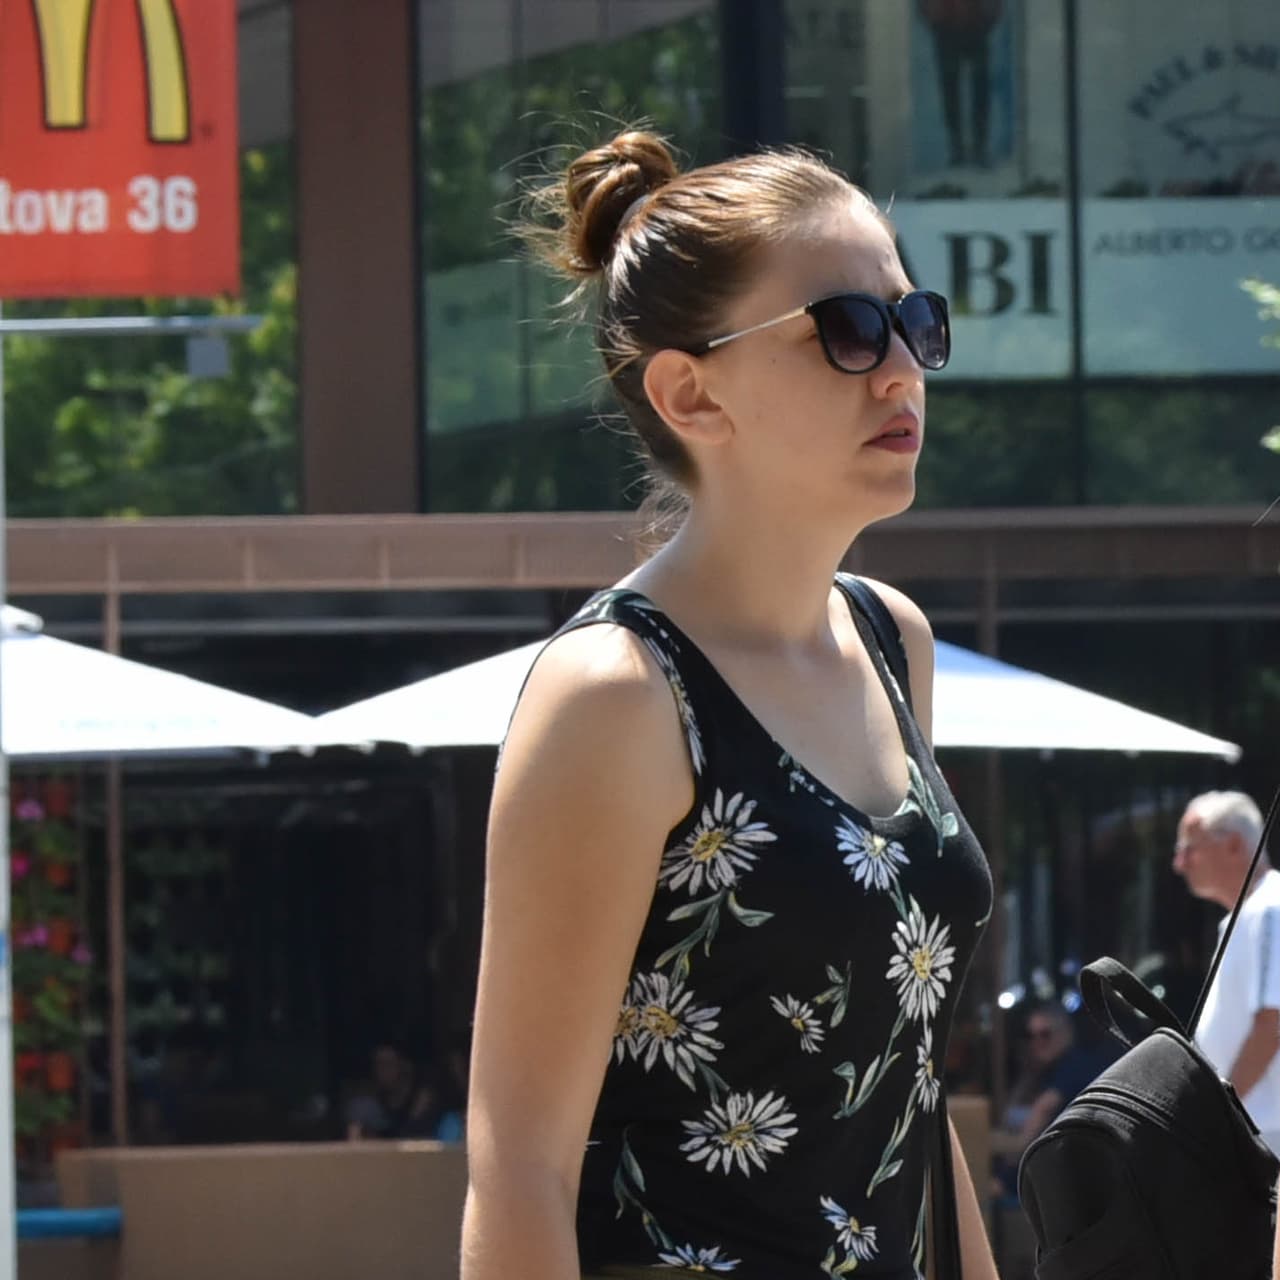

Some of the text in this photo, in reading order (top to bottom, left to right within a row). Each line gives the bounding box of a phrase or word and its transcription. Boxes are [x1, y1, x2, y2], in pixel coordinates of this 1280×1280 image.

[127, 174, 198, 233] 36
[1094, 226, 1235, 257] ALBERTO
[895, 229, 1058, 318] BI
